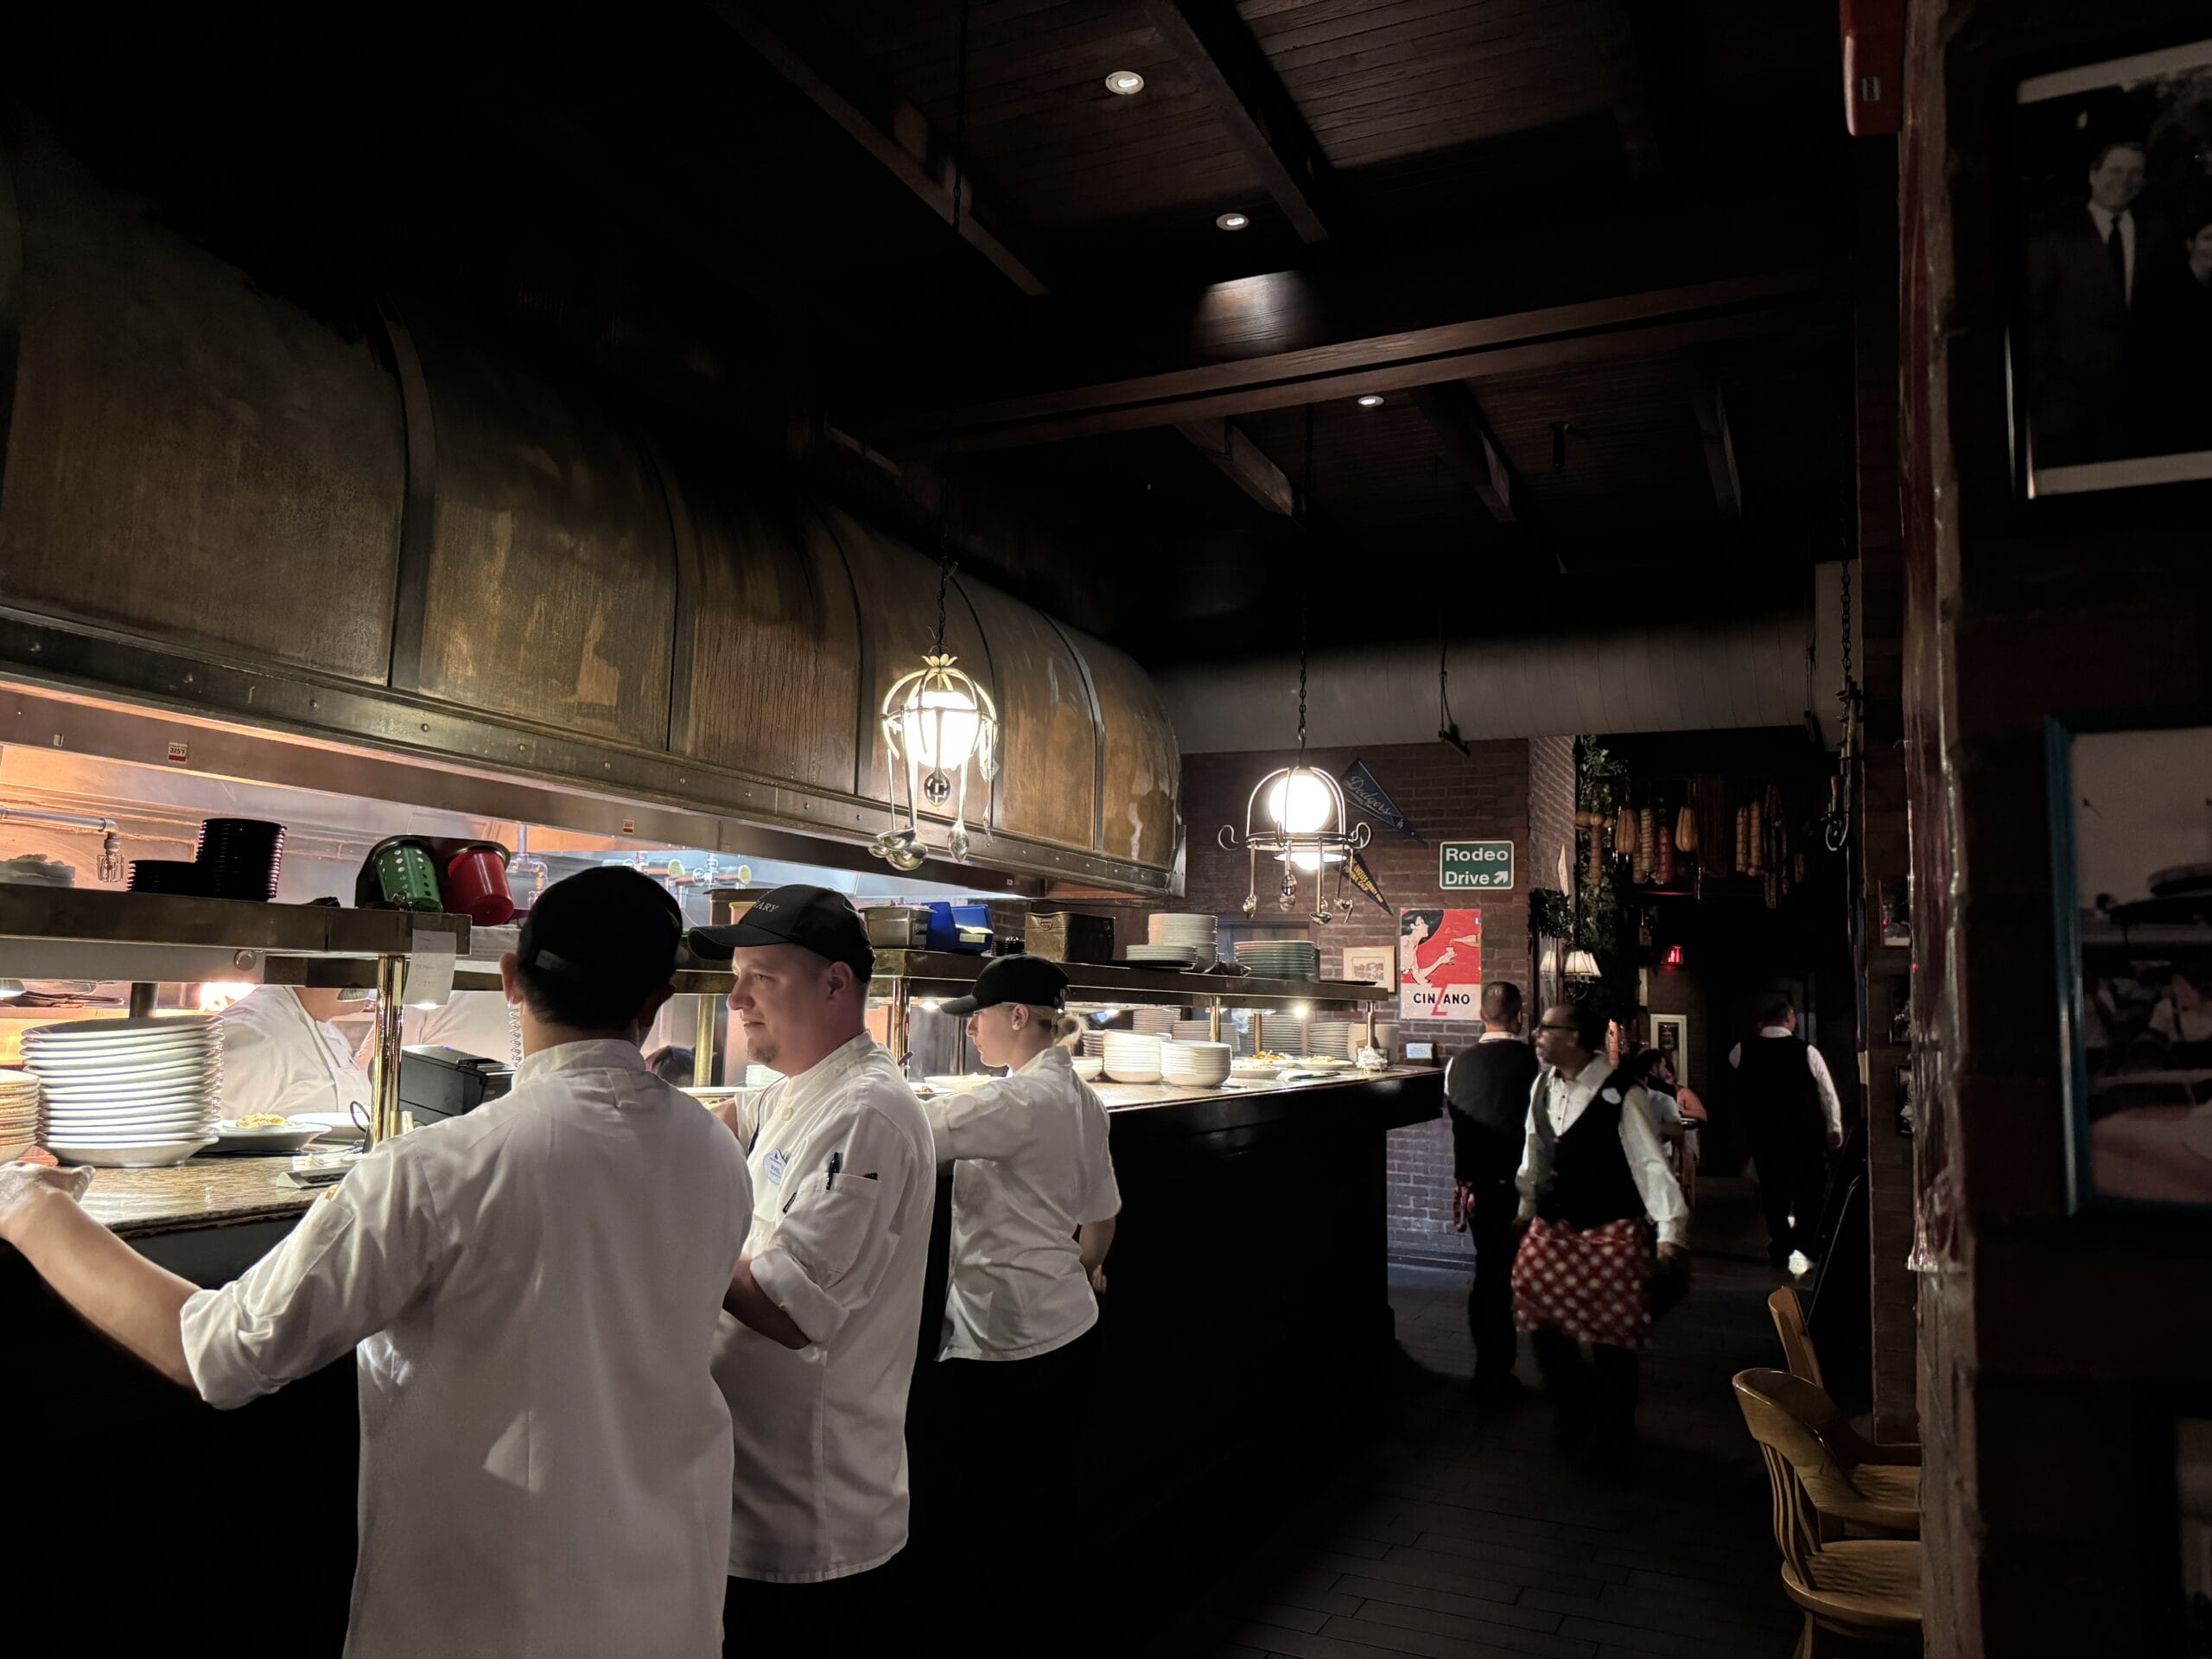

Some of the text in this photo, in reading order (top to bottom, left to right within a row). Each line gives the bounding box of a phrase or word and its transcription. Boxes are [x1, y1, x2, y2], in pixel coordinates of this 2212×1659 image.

[1343, 776, 1392, 815] Dodgers
[1446, 848, 1509, 861] Rodeo
[1445, 871, 1490, 885] Drive
[1413, 983, 1471, 1016] CINZANO
